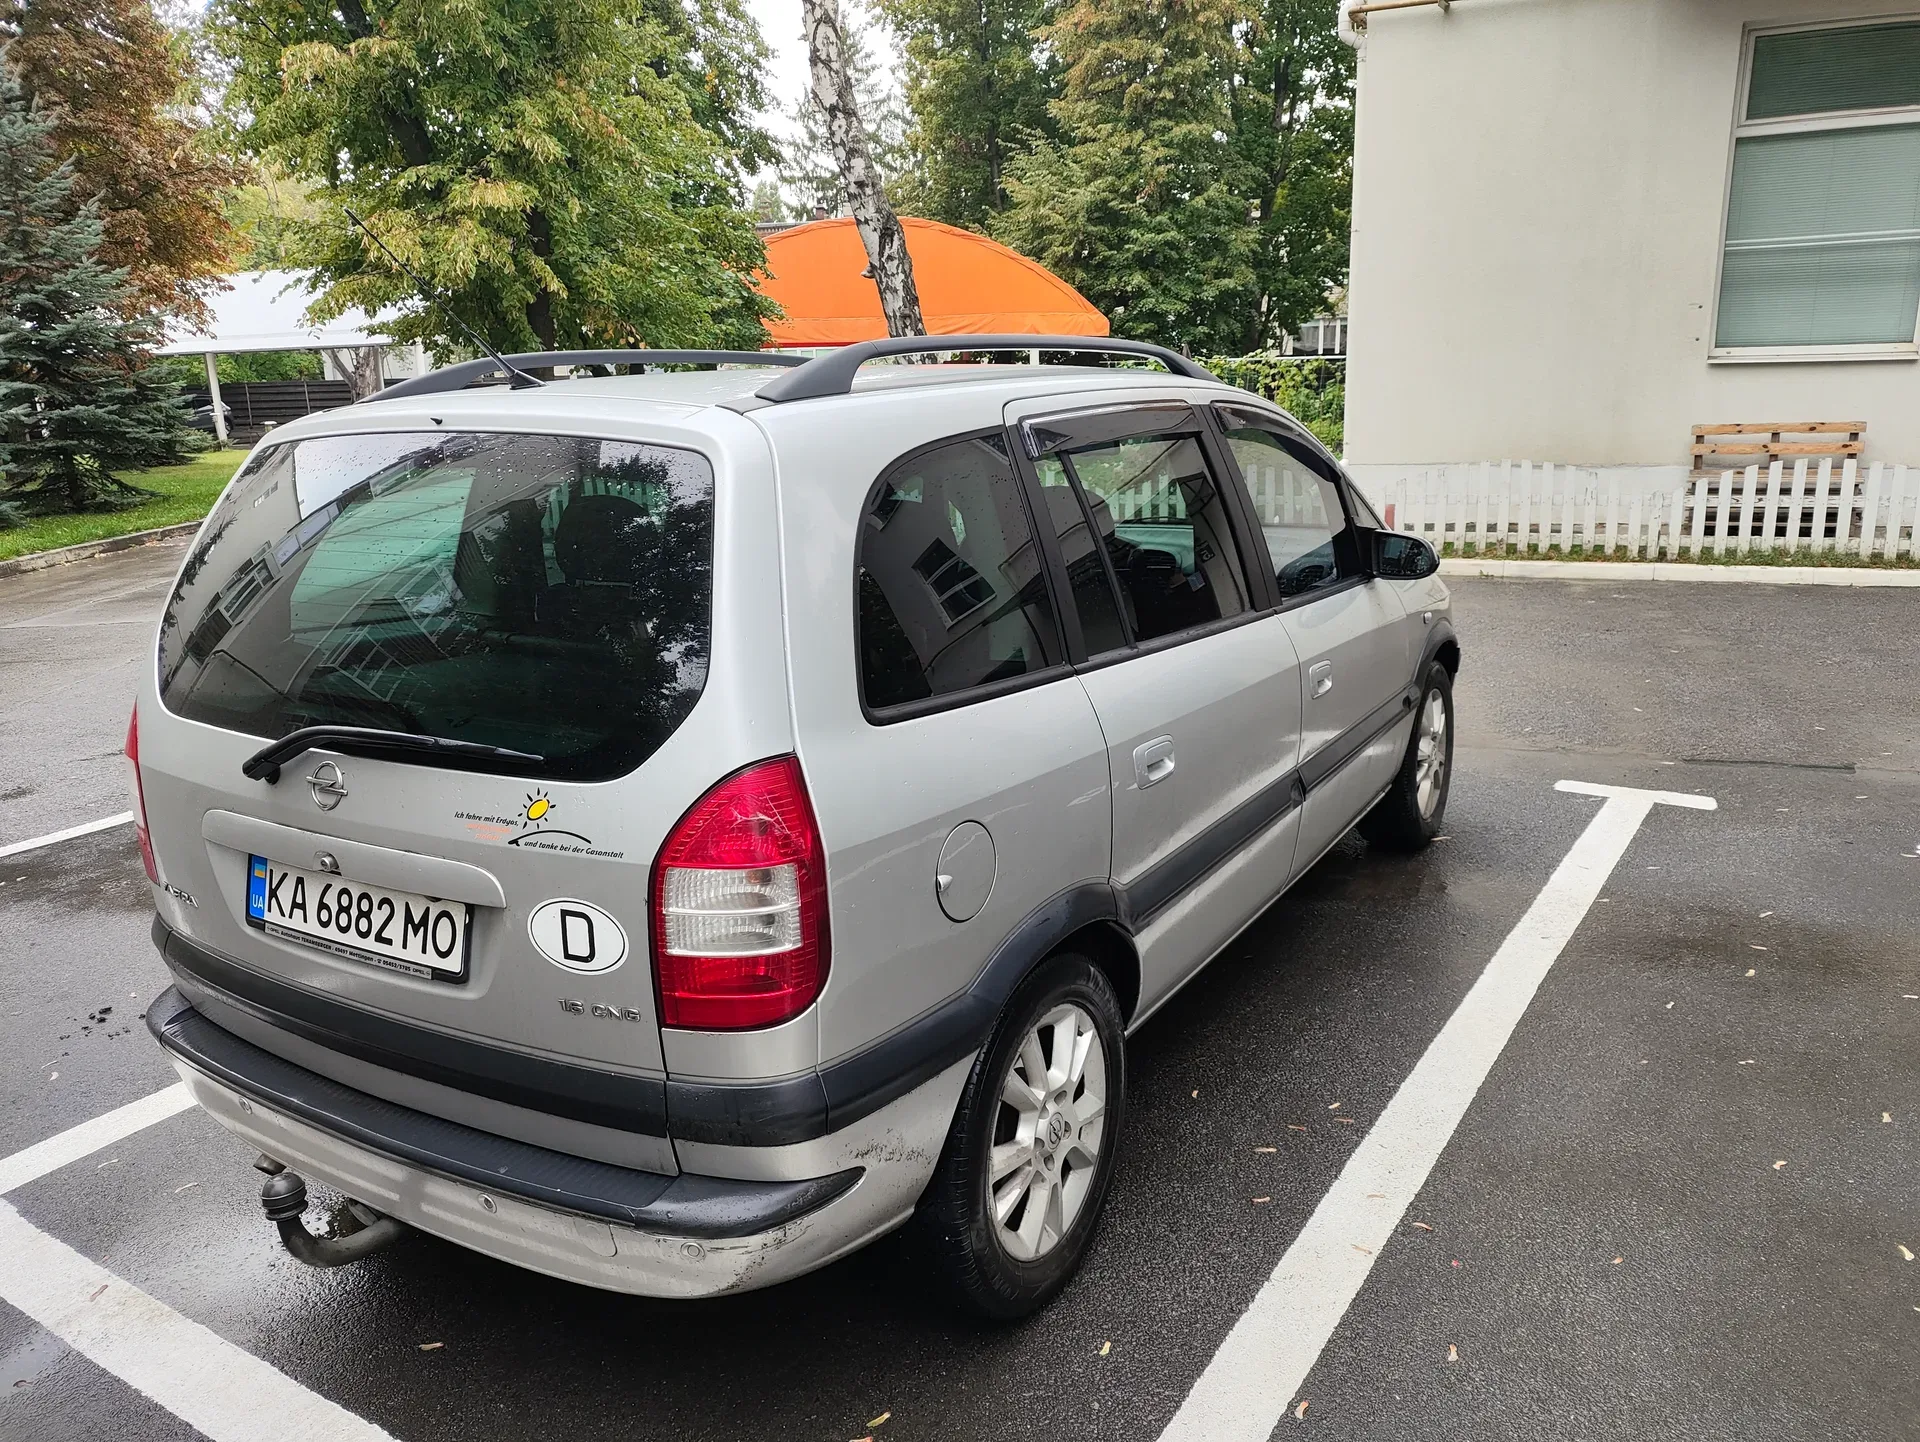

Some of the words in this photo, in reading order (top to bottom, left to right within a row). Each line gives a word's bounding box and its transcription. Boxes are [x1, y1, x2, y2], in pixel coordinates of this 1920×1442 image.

[454, 811, 464, 819] Ich
[465, 812, 483, 821] fahre
[483, 815, 496, 823] mit
[524, 840, 539, 848] und
[539, 841, 559, 851] tanke
[559, 844, 572, 852] bei
[572, 845, 585, 854] der
[252, 894, 264, 910] UA
[267, 868, 308, 924] KA
[316, 883, 396, 947] 6882
[402, 901, 457, 959] MO
[281, 930, 301, 941] Autohaus
[560, 908, 596, 963] D
[591, 1003, 641, 1022] CNG
